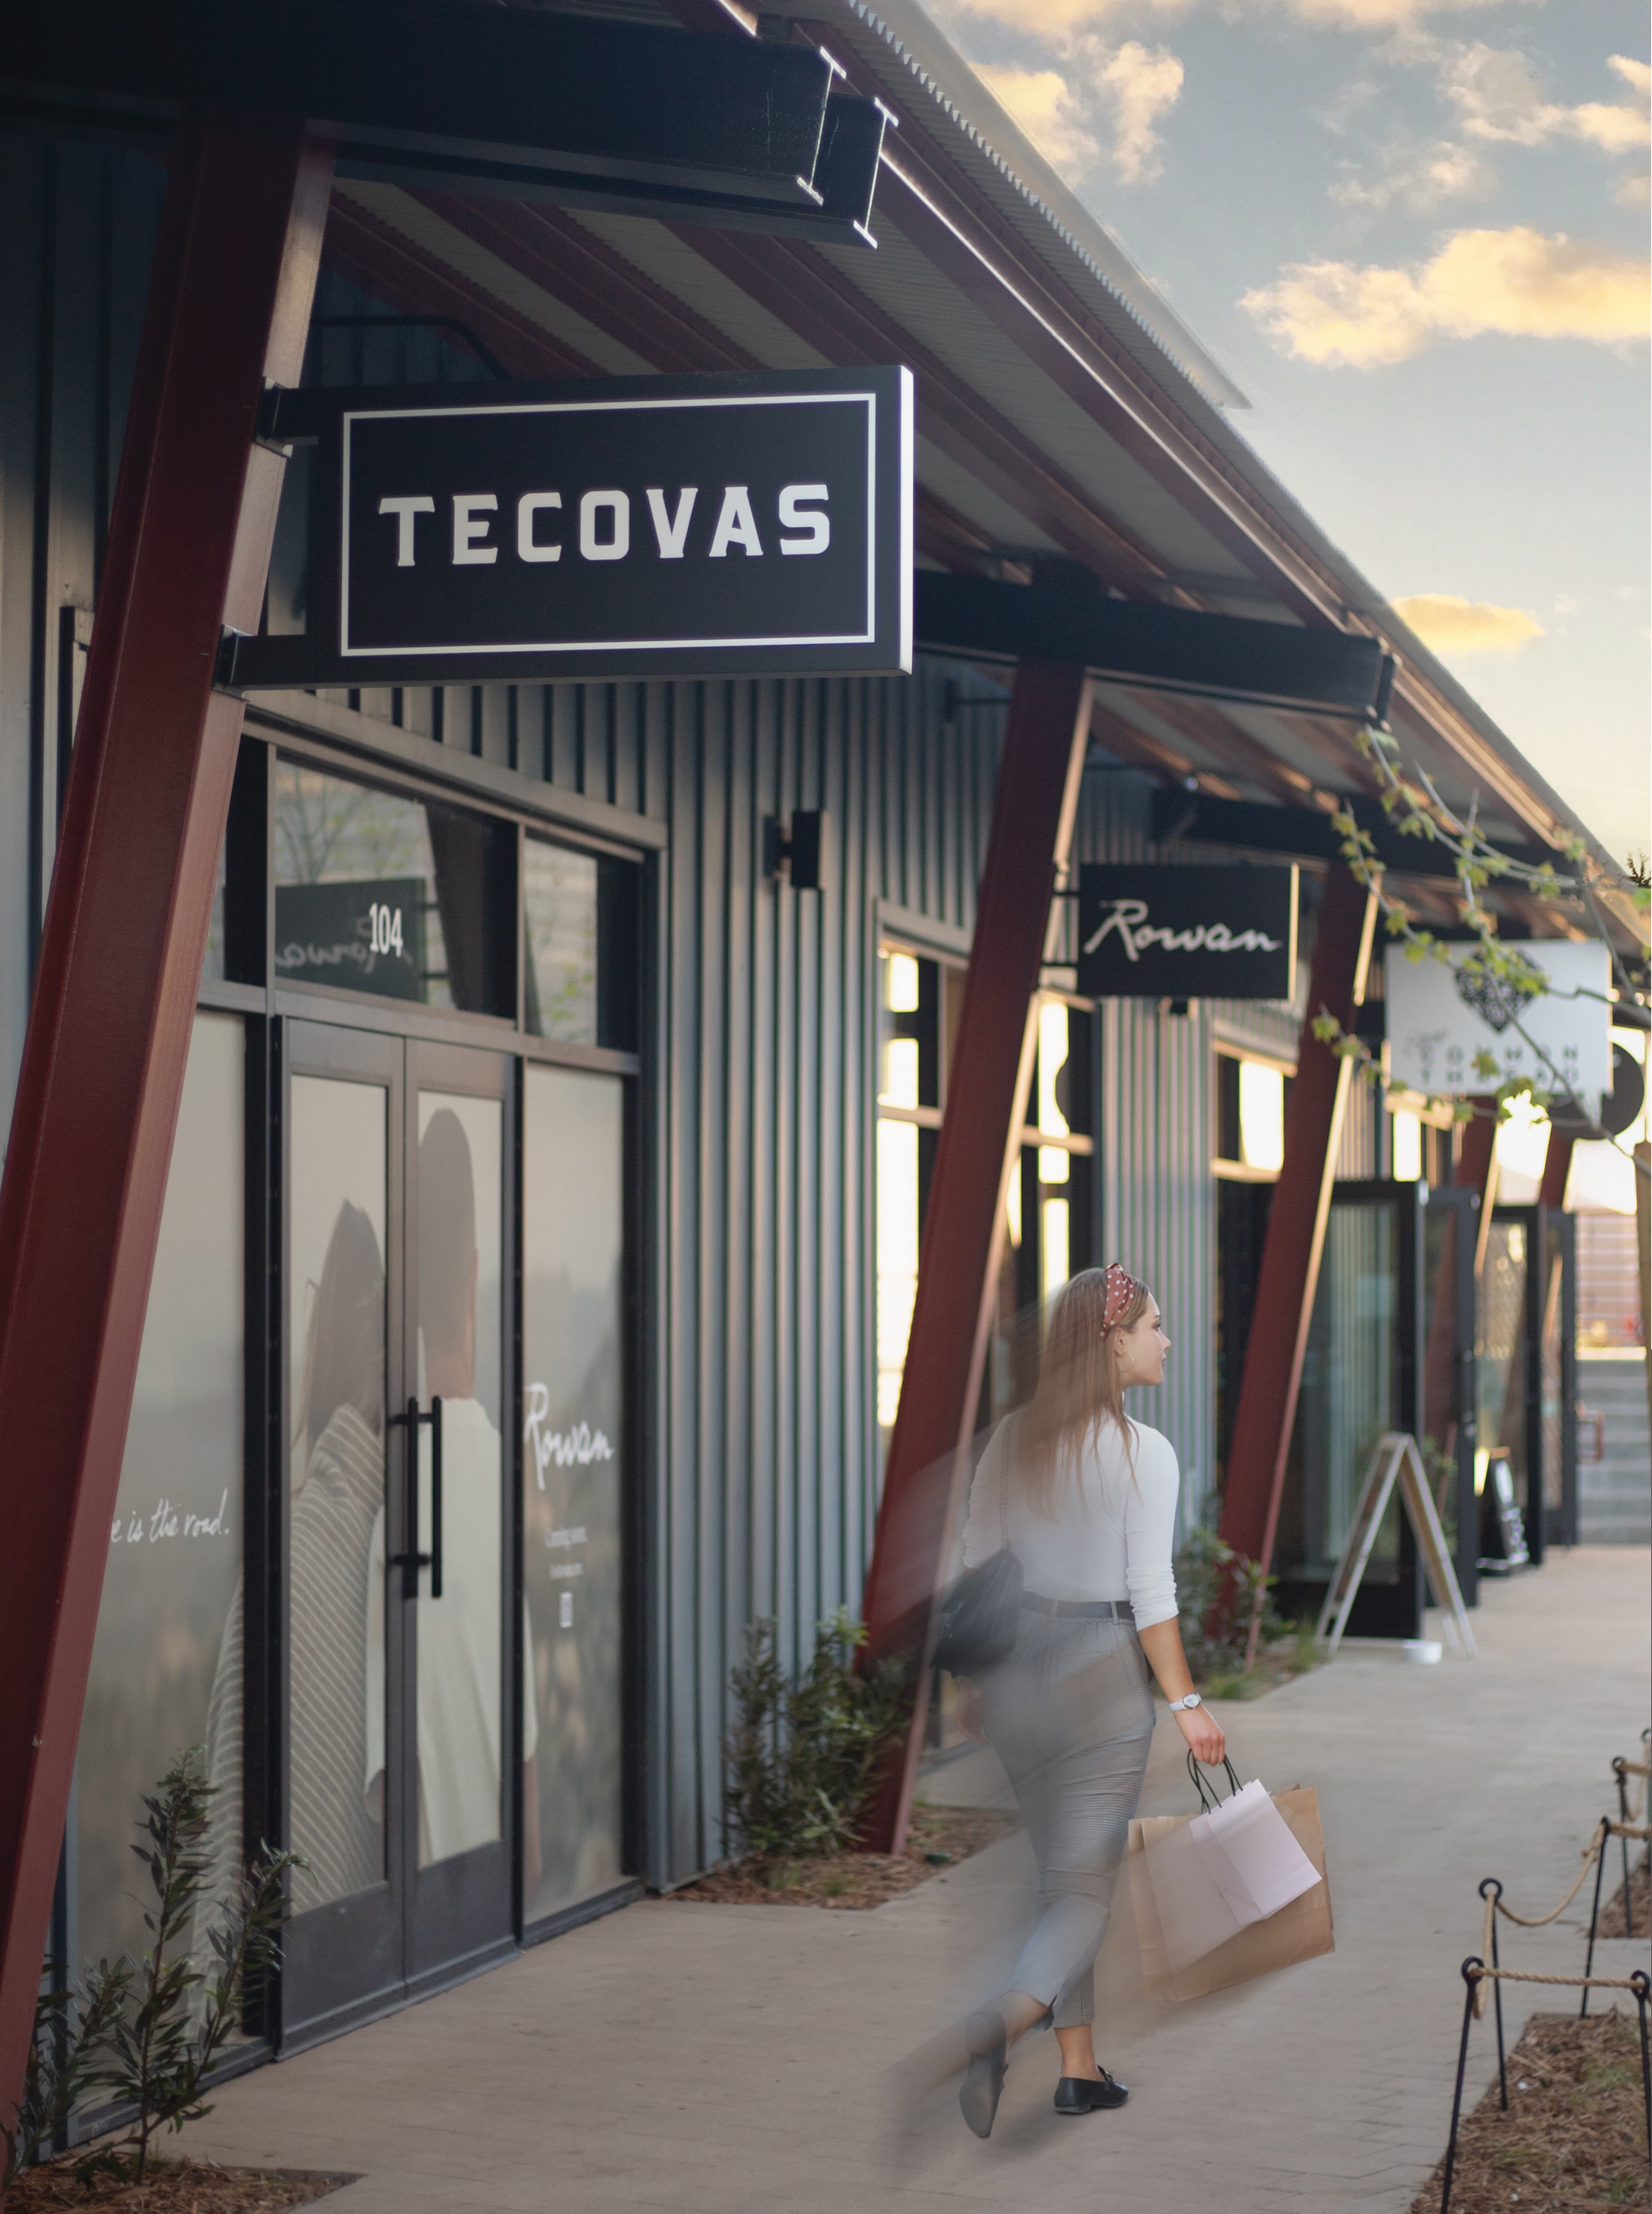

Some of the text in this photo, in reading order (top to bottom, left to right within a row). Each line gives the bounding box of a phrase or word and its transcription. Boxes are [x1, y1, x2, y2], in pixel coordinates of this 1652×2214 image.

[377, 484, 830, 567] TECOVAS
[369, 902, 404, 958] 104
[1083, 899, 1284, 962] Rowan
[524, 1382, 614, 1491] Rowan
[127, 1510, 144, 1543] is
[150, 1498, 180, 1543] the
[184, 1486, 230, 1538] road.
